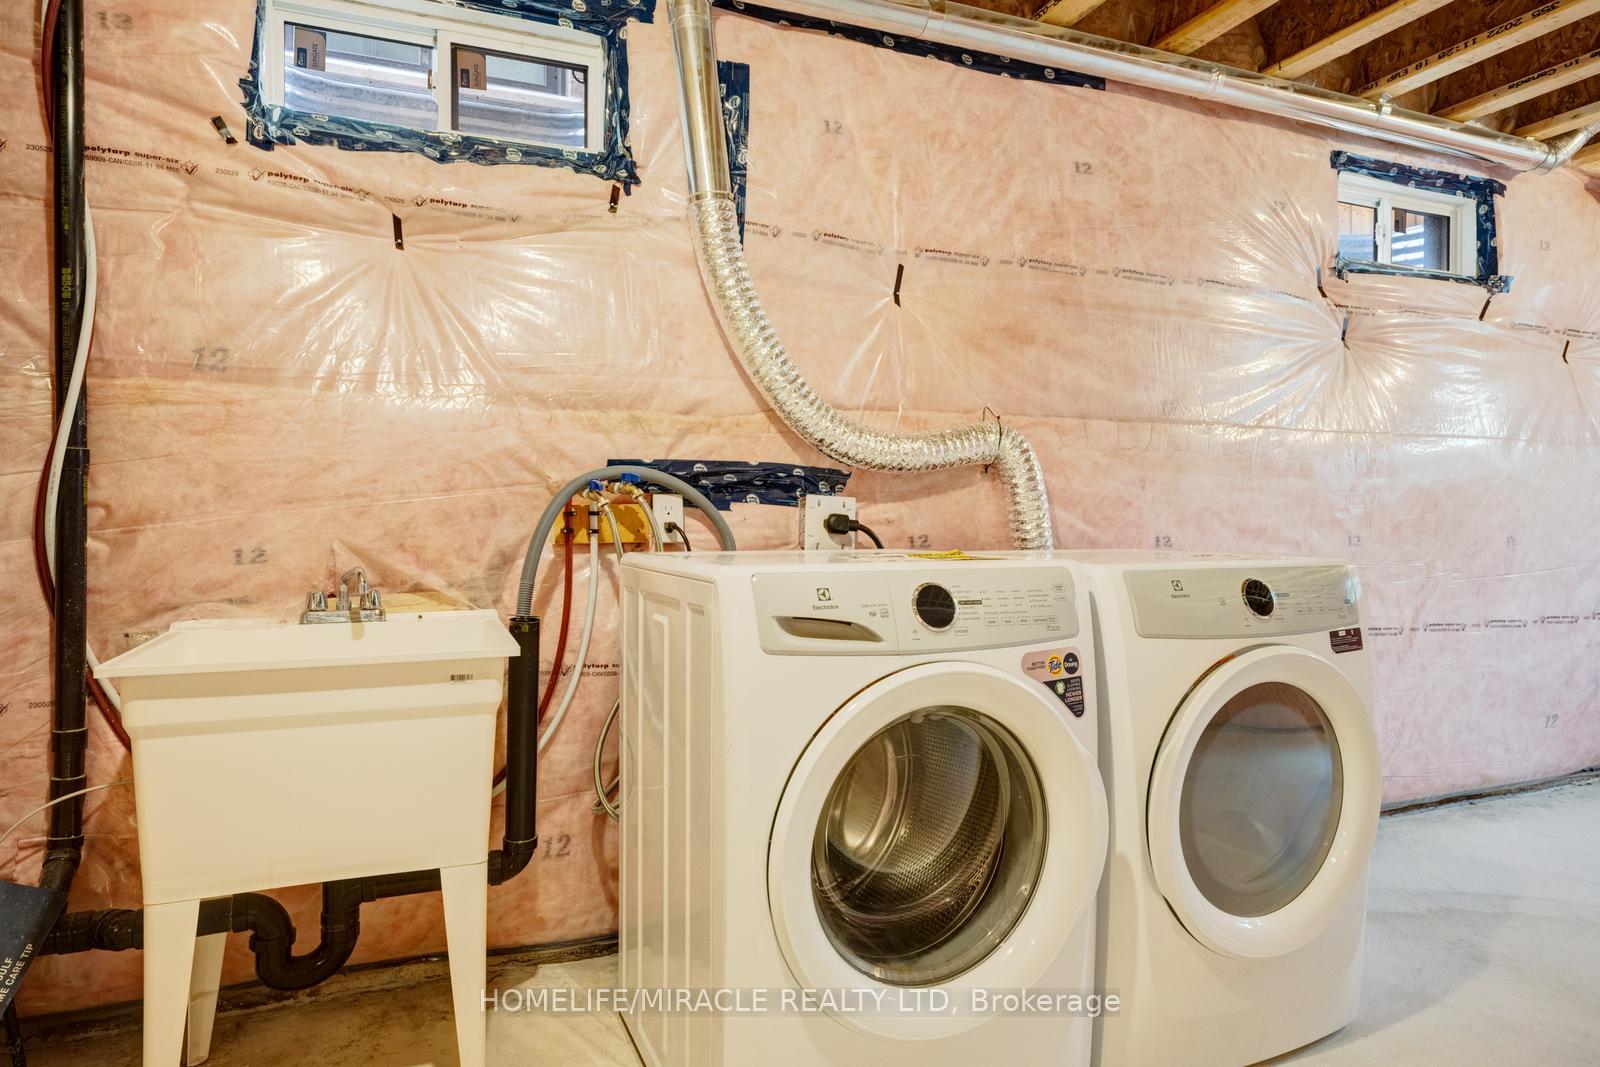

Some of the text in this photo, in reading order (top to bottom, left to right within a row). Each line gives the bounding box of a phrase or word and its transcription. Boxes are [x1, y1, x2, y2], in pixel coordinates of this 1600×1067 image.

[1486, 18, 1522, 38] 2022
[1507, 68, 1557, 89] Canada
[84, 145, 180, 164] polytarp super-six
[1073, 161, 1094, 176] 12
[267, 170, 310, 183] polytarp
[430, 197, 468, 208] polytarp
[909, 535, 931, 548] 12
[1155, 535, 1173, 547] 12
[232, 547, 268, 565] 12
[812, 603, 839, 611] Electrolux
[1048, 660, 1062, 674] Tide
[542, 833, 572, 860] 12
[5, 960, 26, 986] CARE
[20, 943, 34, 964] TIP
